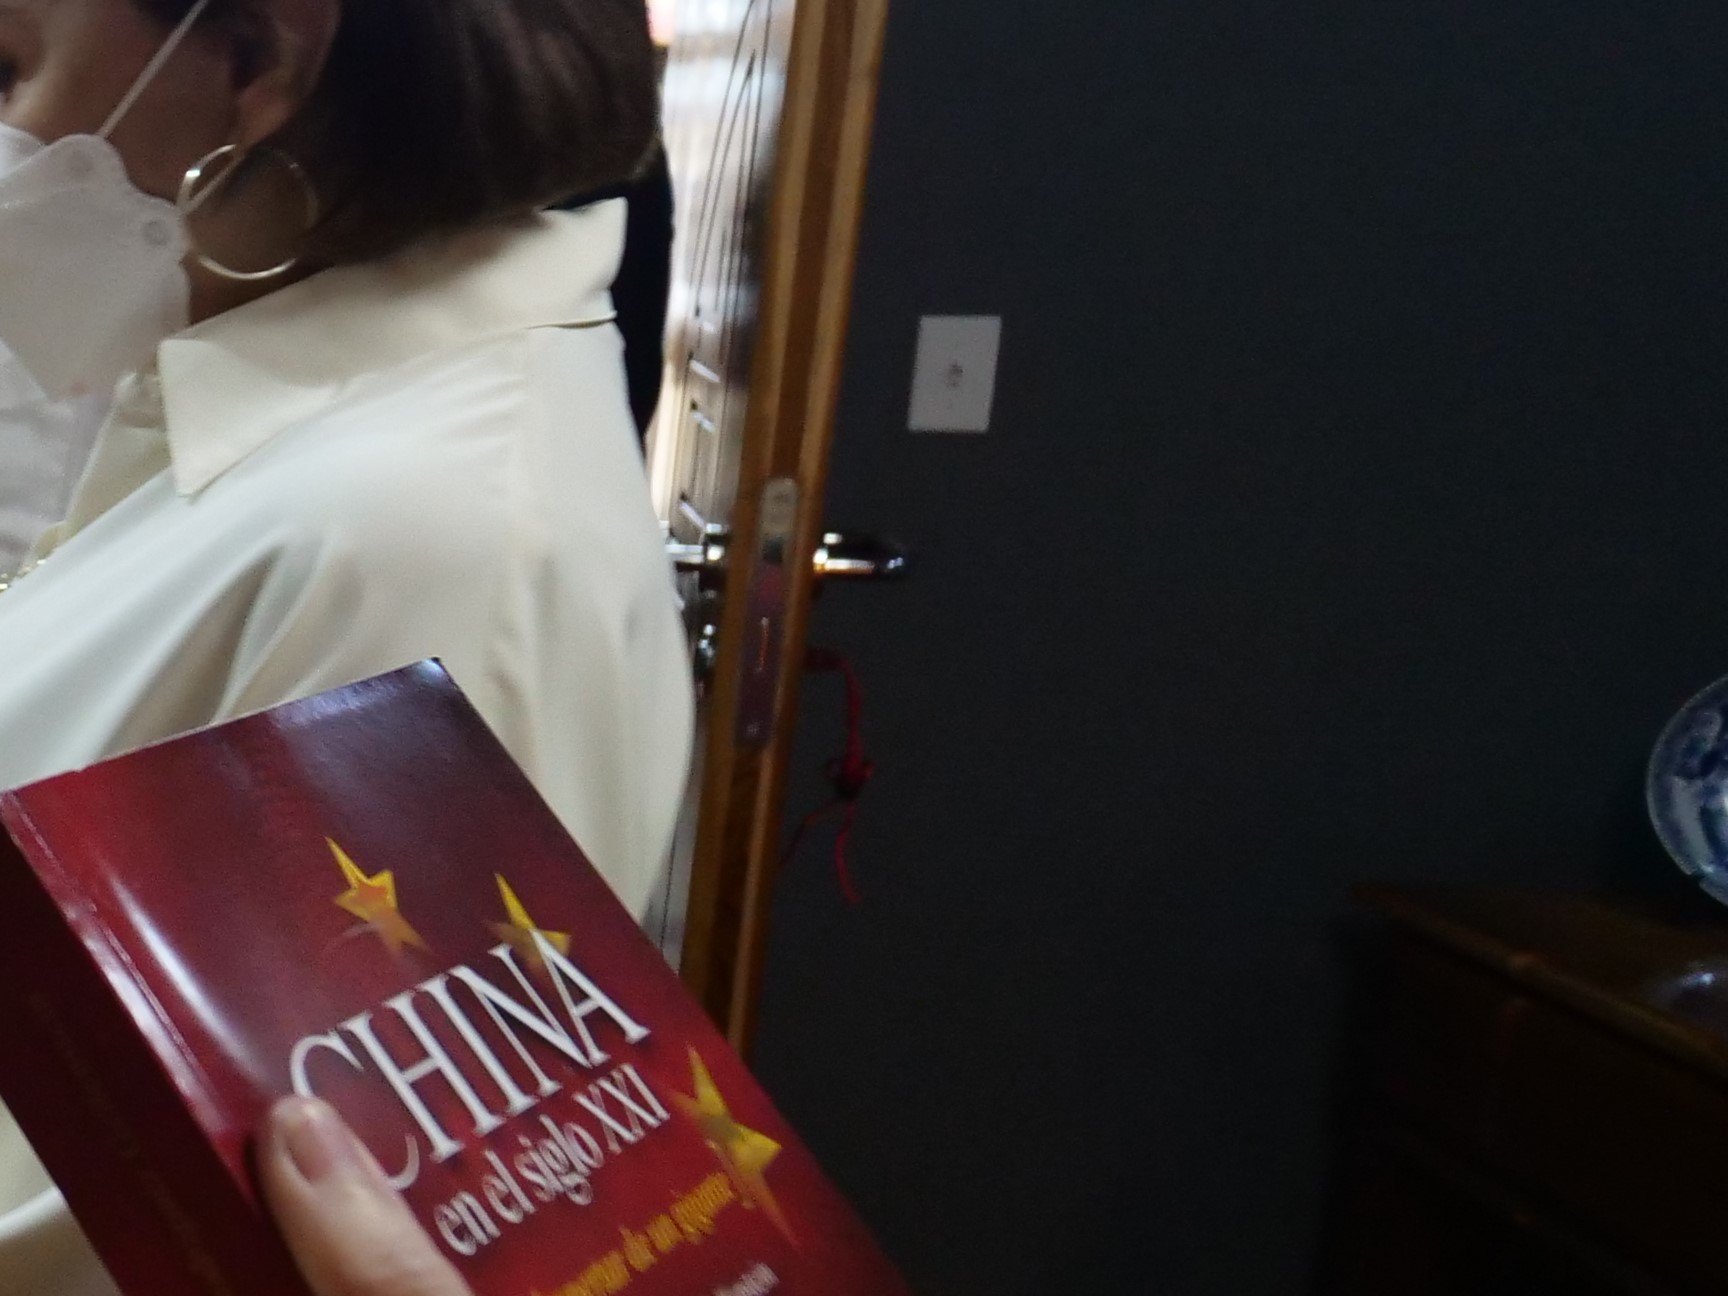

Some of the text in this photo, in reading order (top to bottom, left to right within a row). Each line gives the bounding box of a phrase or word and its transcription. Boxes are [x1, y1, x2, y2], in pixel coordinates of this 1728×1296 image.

[290, 929, 652, 1192] CHINA
[433, 1062, 671, 1256] en el siglo XXI
